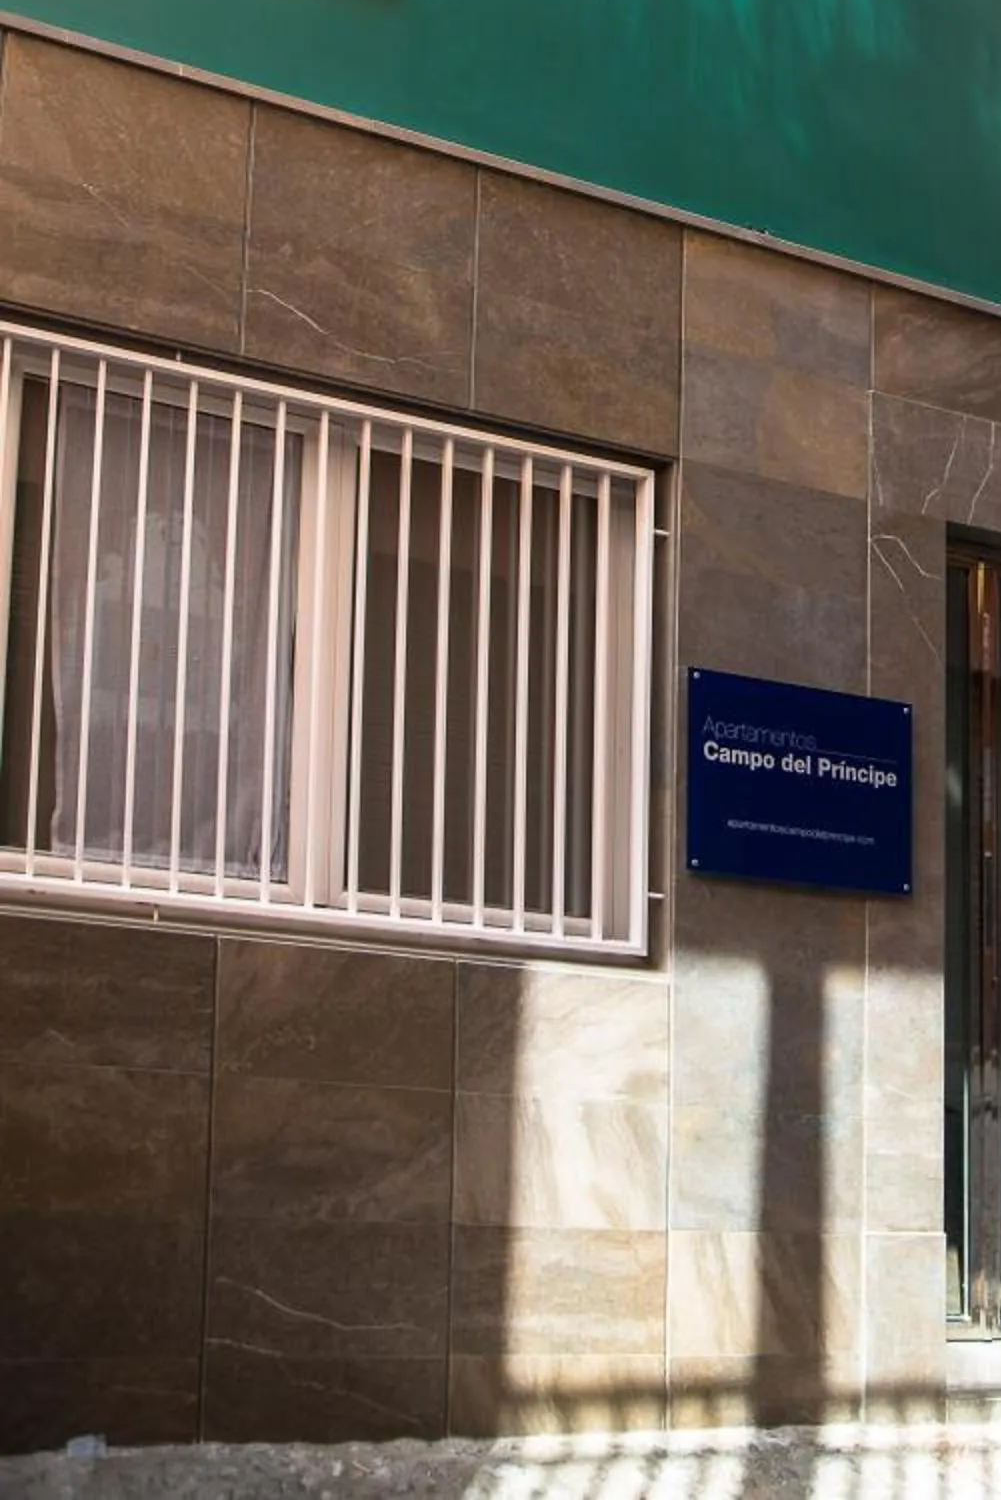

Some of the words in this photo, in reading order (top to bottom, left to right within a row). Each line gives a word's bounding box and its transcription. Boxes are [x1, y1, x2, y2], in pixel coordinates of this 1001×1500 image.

[703, 715, 817, 750] Apartamentos
[703, 740, 775, 771] Campo
[781, 753, 811, 775] del
[818, 757, 897, 788] Príncipe
